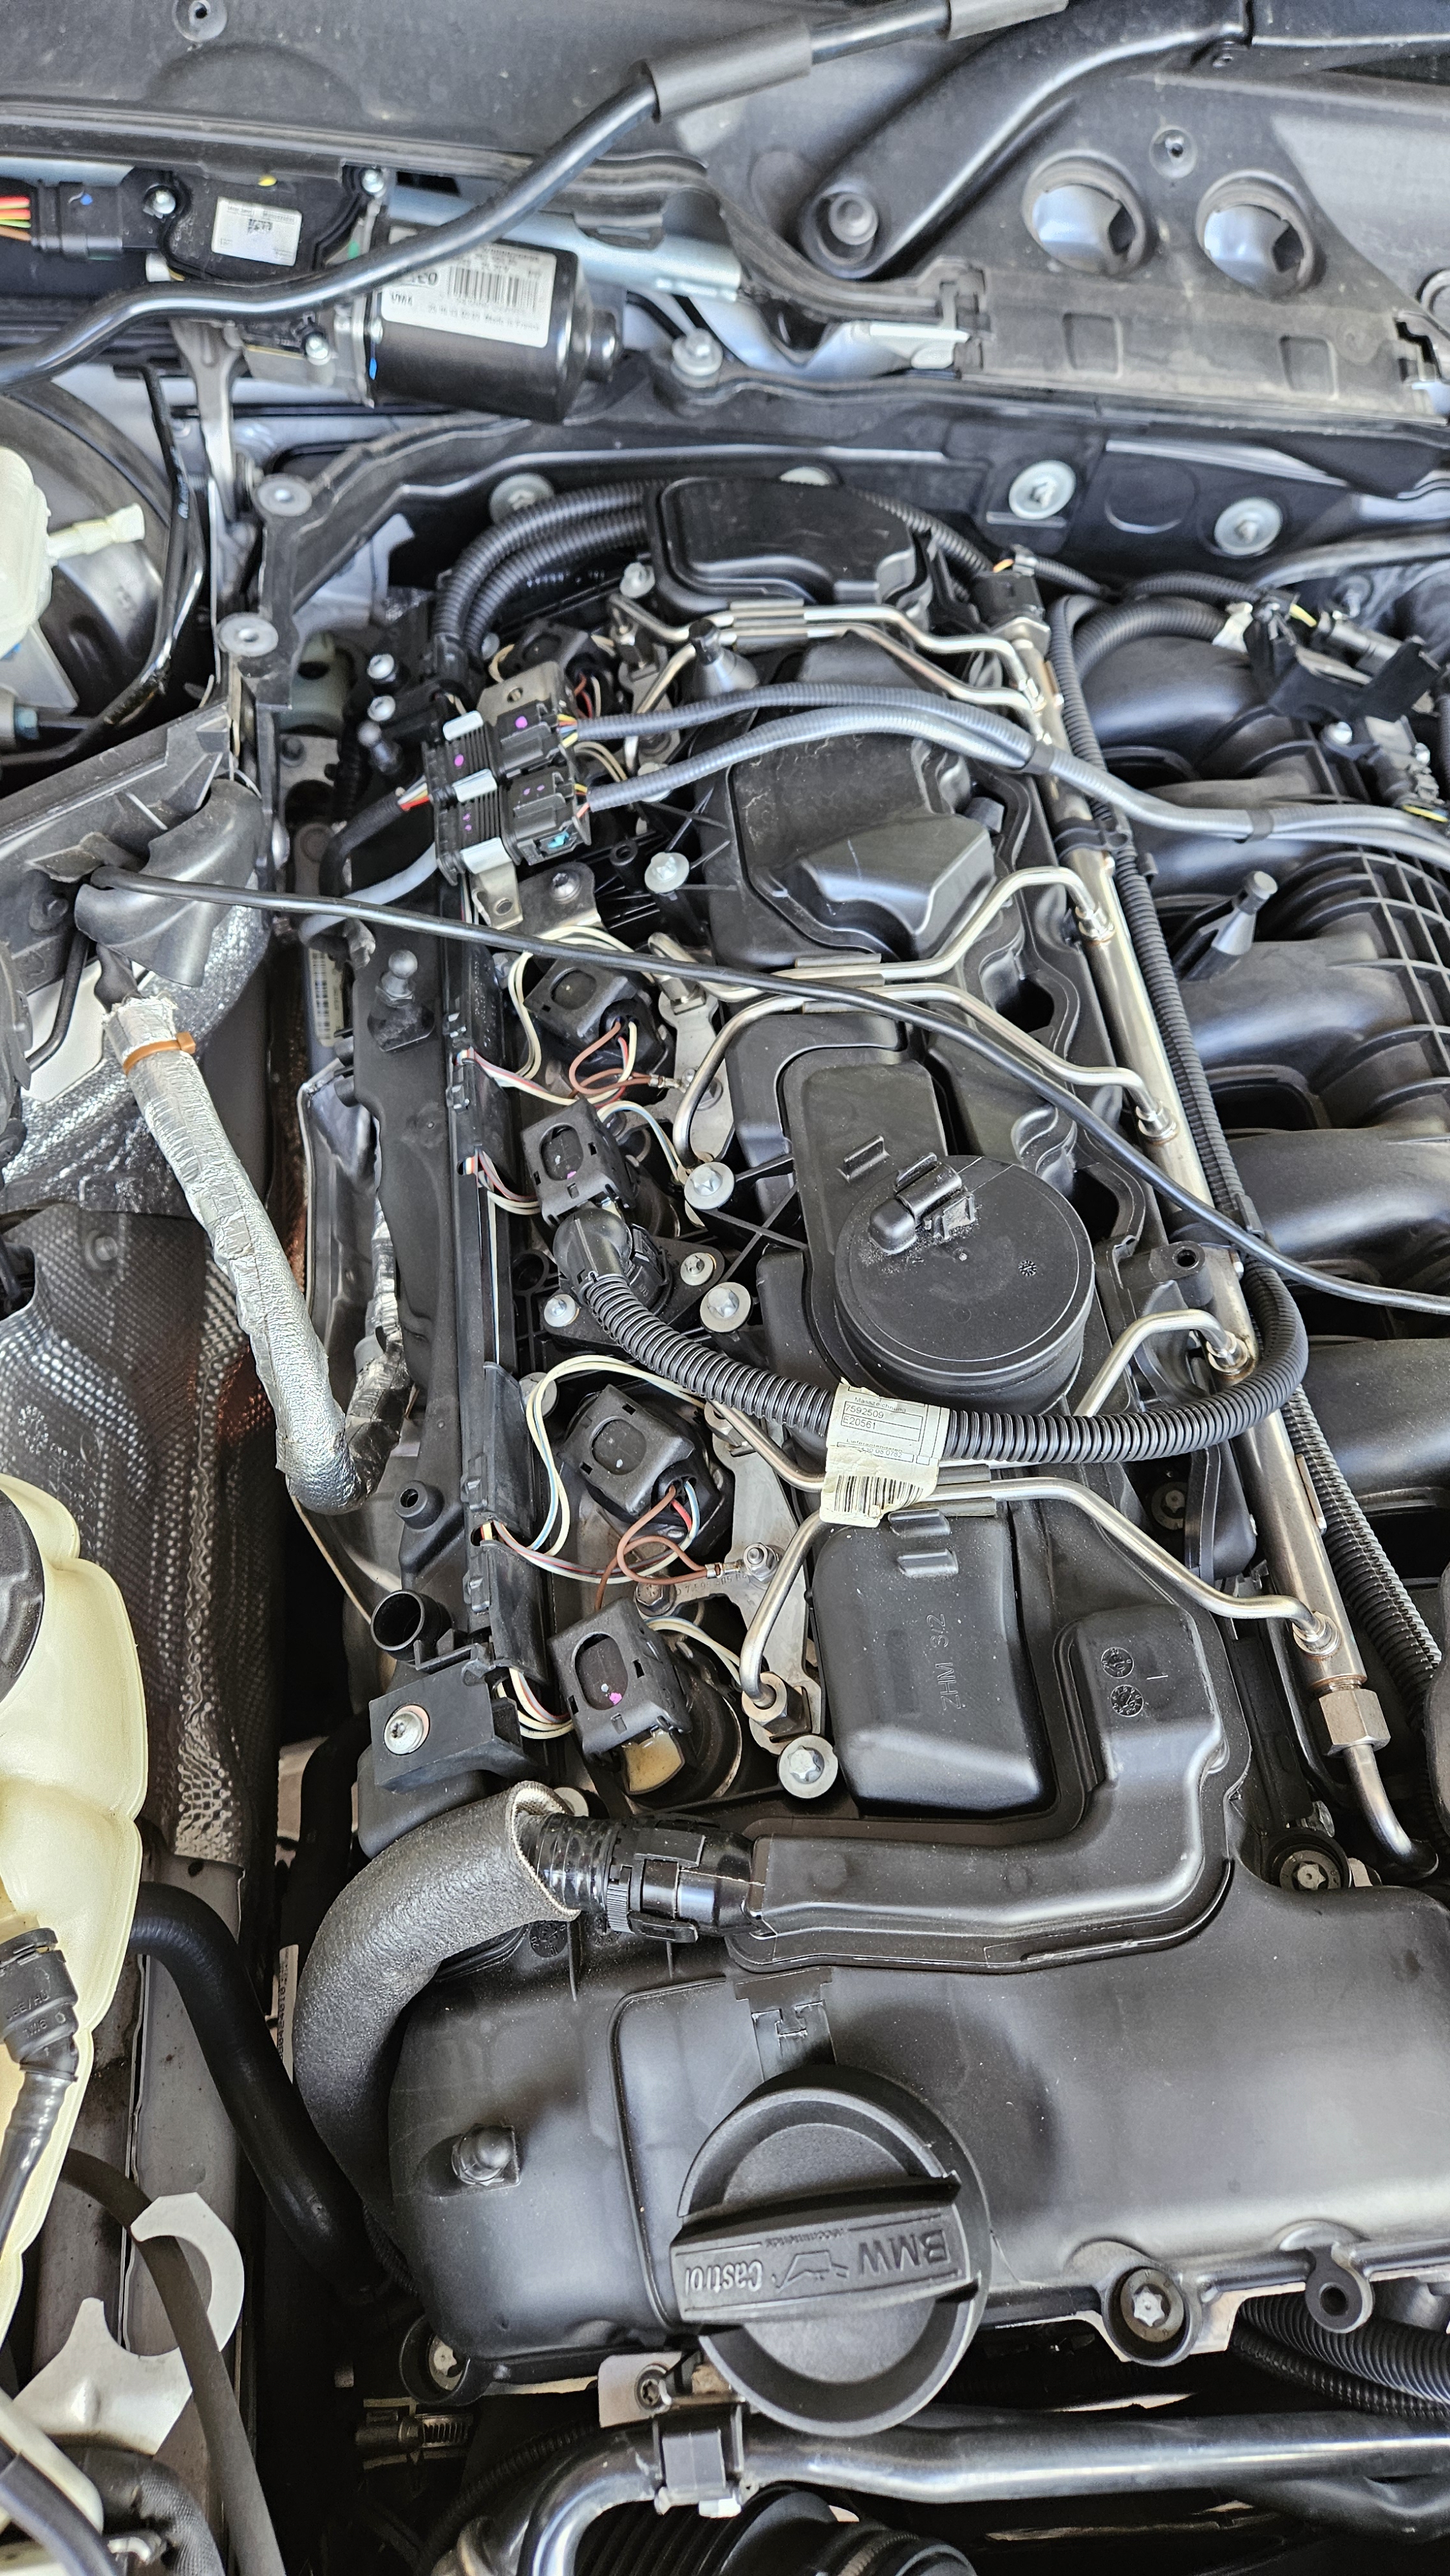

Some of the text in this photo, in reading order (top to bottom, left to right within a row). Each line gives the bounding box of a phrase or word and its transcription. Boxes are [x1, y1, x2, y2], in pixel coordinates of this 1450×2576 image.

[843, 1416, 876, 1430] E20561
[845, 1404, 885, 1419] 7592509
[935, 1662, 961, 1710] ZHM
[684, 2230, 952, 2297] BMW Castrol
